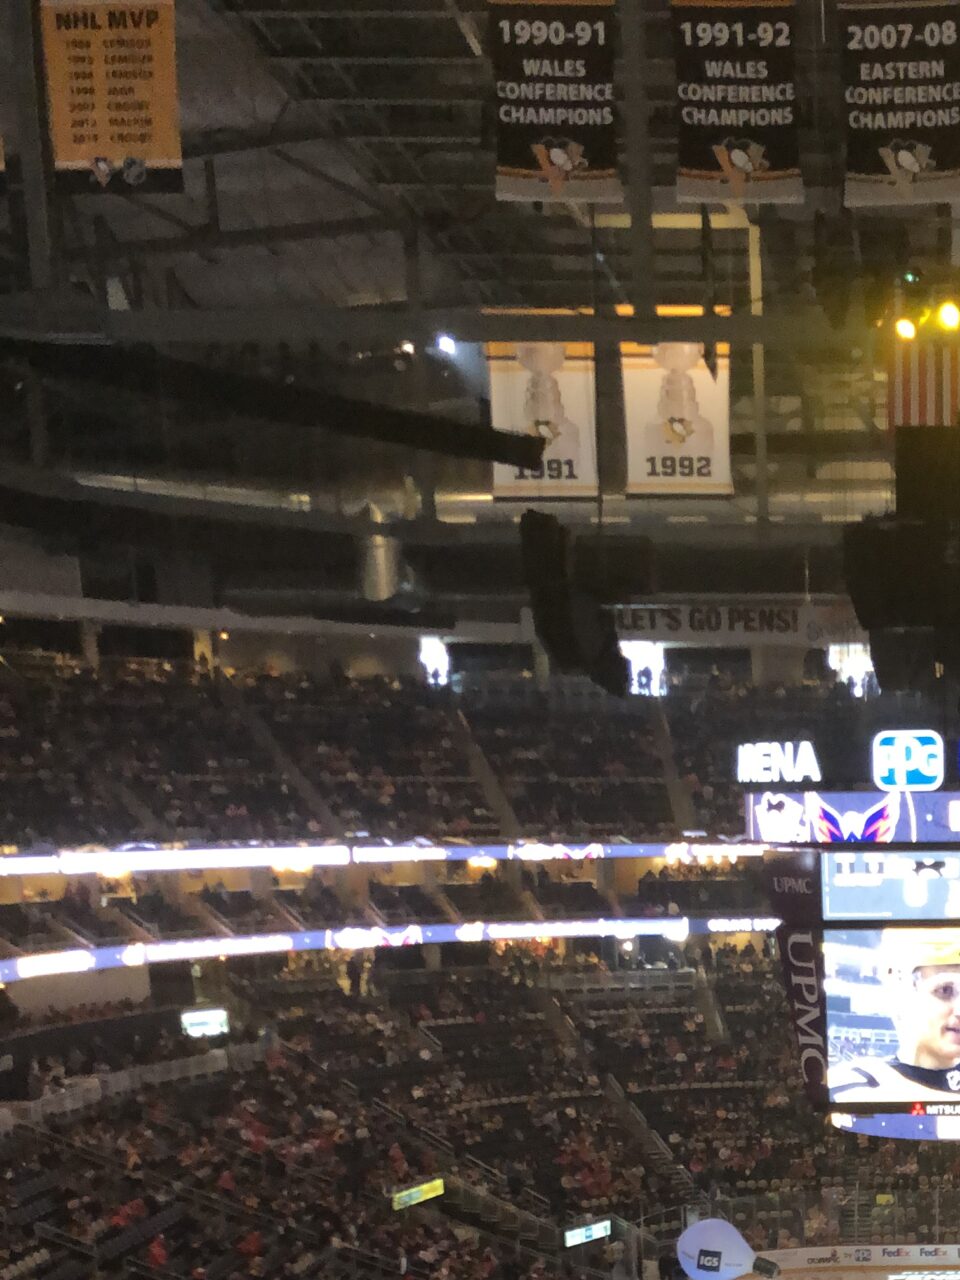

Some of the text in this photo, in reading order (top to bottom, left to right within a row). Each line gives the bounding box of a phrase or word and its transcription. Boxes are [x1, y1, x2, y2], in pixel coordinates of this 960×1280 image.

[56, 9, 158, 30] NHL MVP
[499, 20, 605, 46] 1990-91
[680, 21, 791, 47] 1991-92
[847, 20, 958, 50] 2007-08
[522, 59, 587, 77] WALES
[704, 60, 768, 79] WALES
[860, 60, 944, 80] EASTERN
[496, 81, 614, 100] CONFERENCE
[678, 83, 795, 103] CONFERENCE
[845, 82, 960, 104] CONFERENCE
[500, 105, 613, 124] CHAMPIONS
[682, 107, 793, 126] CHAMPIONS
[848, 107, 960, 129] CHAMPIONS
[647, 456, 711, 477] 1992
[616, 607, 682, 631] LET'S
[689, 607, 722, 631] GO
[728, 608, 799, 633] PENS!
[879, 735, 939, 787] PPG
[773, 877, 813, 894] UPMC
[787, 931, 827, 1085] UPMC
[700, 1256, 719, 1267] IGS
[882, 1248, 911, 1257] FedEx
[919, 1247, 947, 1257] FedEx
